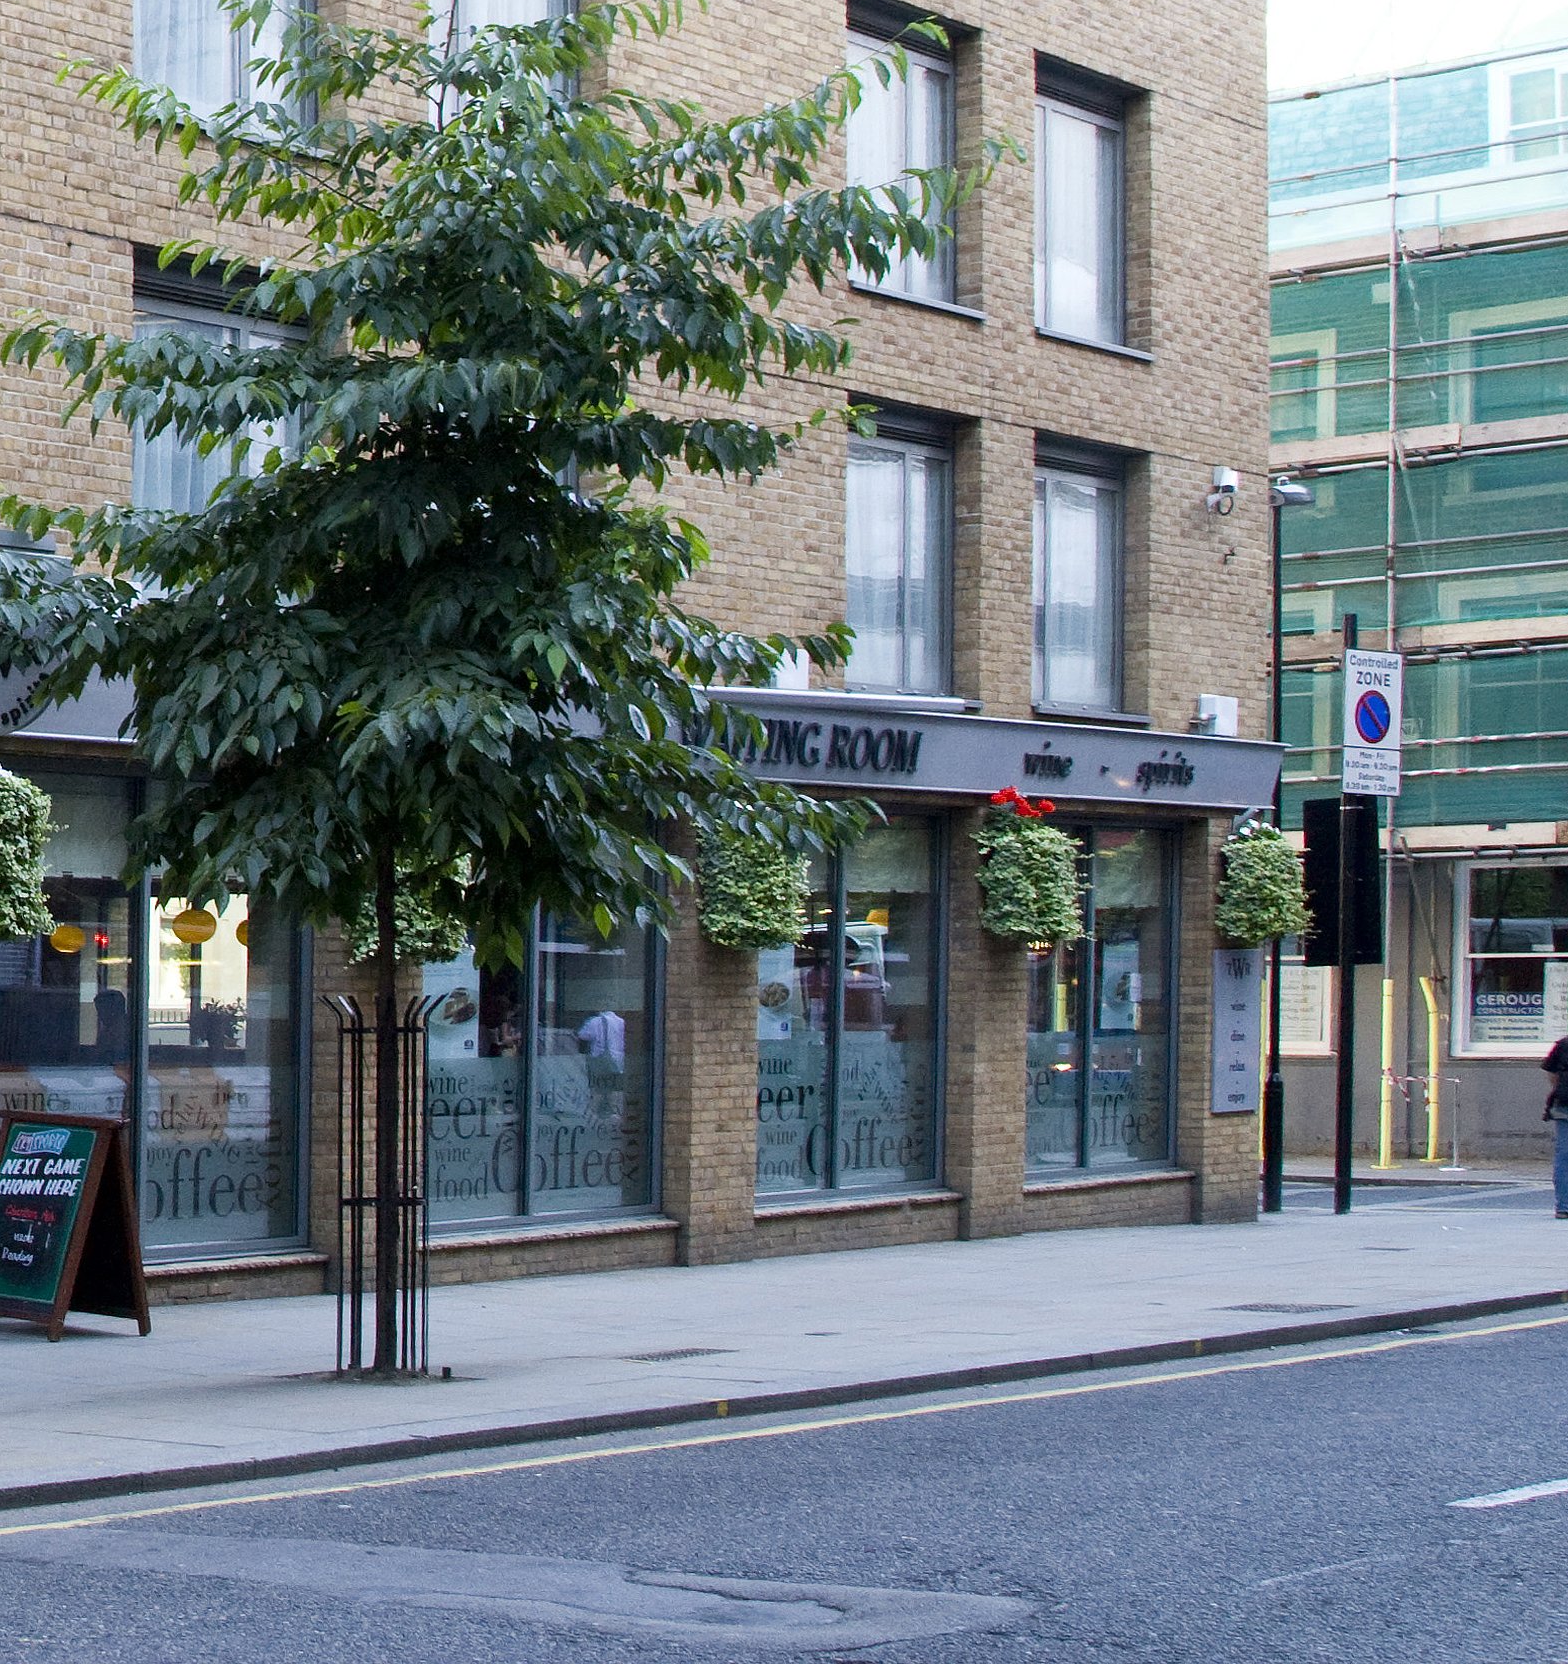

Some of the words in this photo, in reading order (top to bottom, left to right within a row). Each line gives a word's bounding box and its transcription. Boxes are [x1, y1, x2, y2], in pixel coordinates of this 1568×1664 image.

[1349, 654, 1399, 670] Controlled
[1356, 671, 1391, 687] ZONE
[825, 723, 923, 775] ROOM
[1023, 740, 1073, 778] wine
[1135, 750, 1195, 792] spirits
[428, 1097, 497, 1140] eer
[757, 1085, 814, 1124] eer
[0, 1158, 42, 1176] NEXT
[43, 1158, 86, 1176] GAME
[434, 1161, 489, 1204] food
[44, 1179, 82, 1197] HERE
